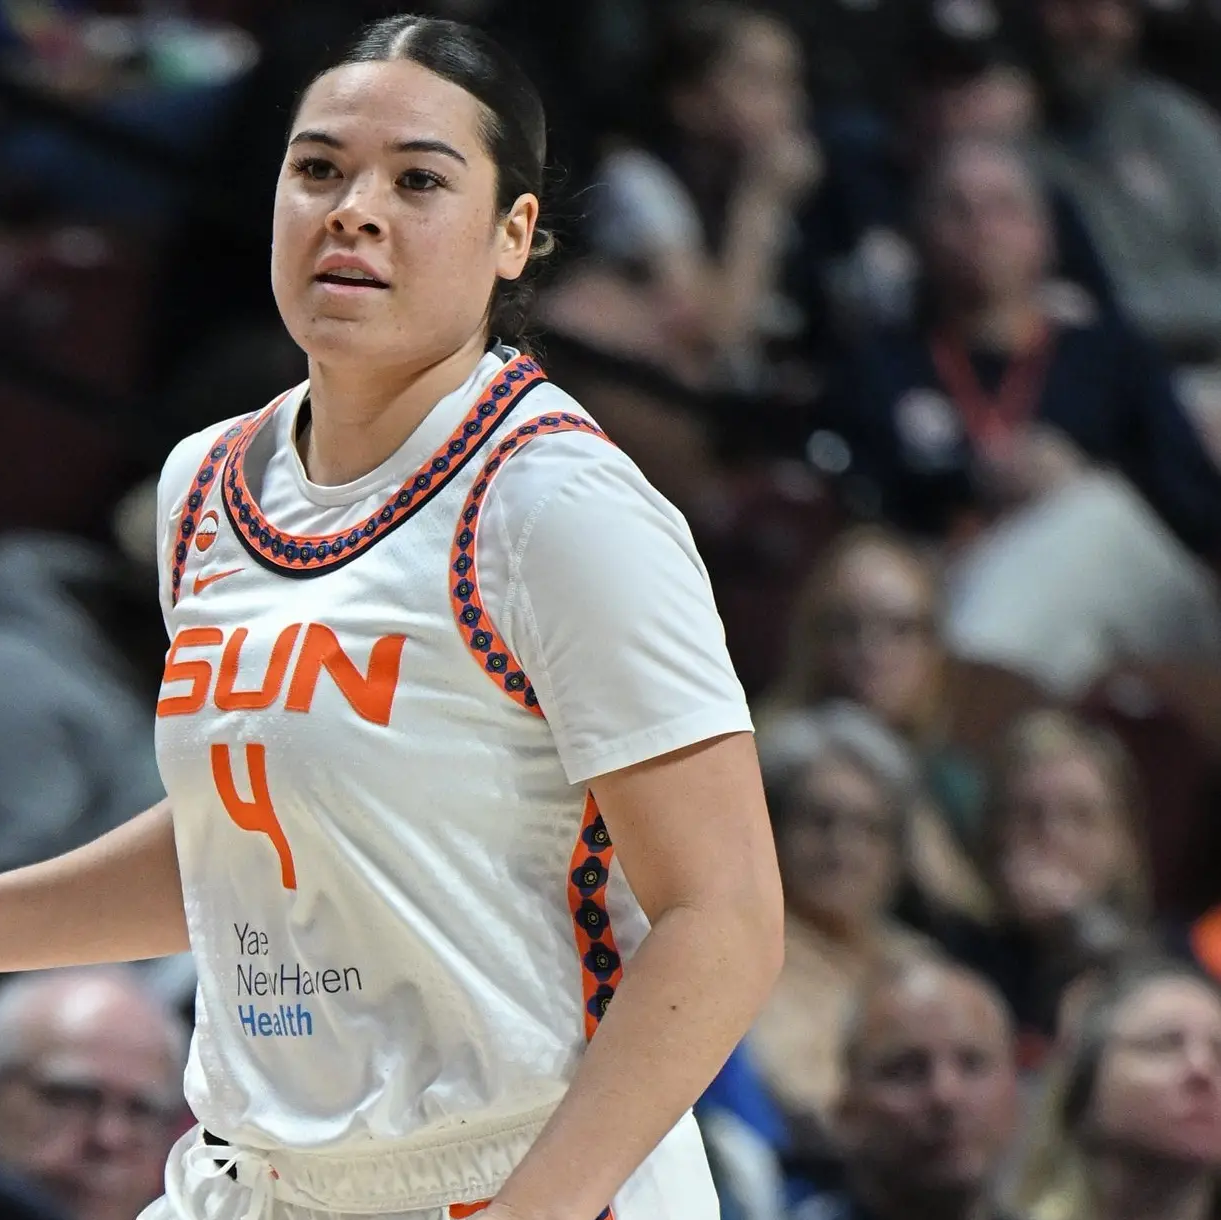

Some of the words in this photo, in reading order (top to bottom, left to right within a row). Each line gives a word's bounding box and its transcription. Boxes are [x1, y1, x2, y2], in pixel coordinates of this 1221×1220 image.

[156, 622, 407, 728] SUN
[210, 743, 297, 890] 4
[233, 922, 269, 956] Yae
[237, 1003, 313, 1037] Health
